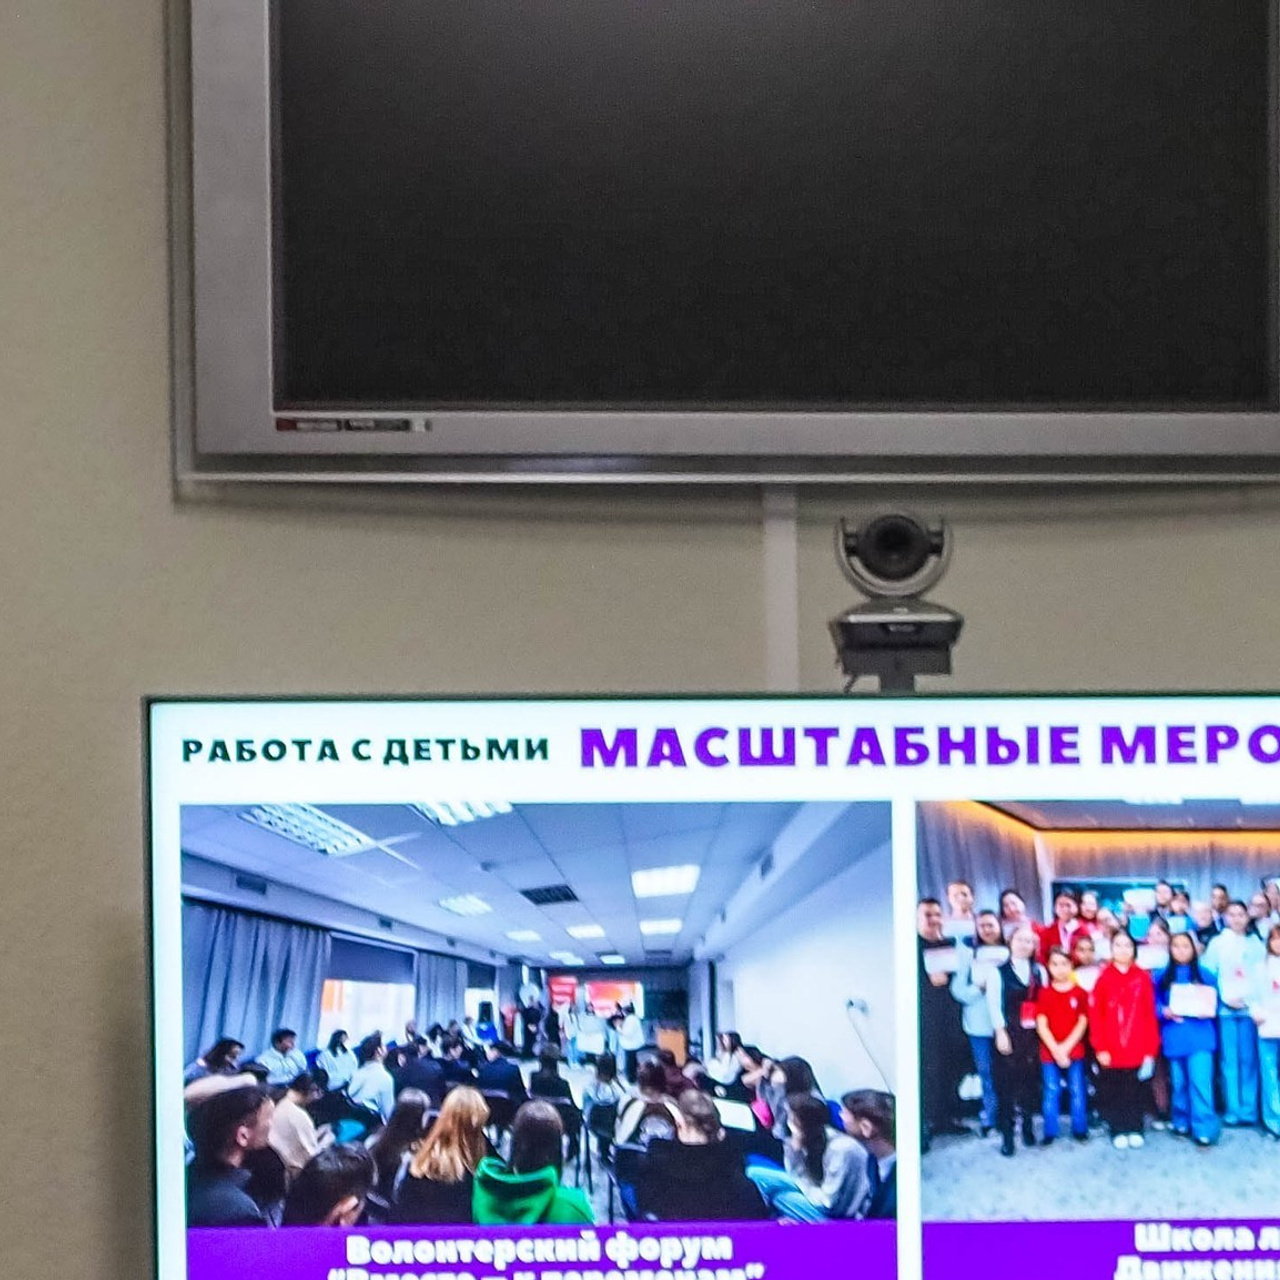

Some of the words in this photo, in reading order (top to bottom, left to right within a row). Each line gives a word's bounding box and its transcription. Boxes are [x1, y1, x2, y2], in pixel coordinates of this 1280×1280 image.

[182, 738, 340, 763] РАБОТА
[351, 738, 372, 762] С
[382, 737, 549, 766] ДЕТЬМИ
[579, 725, 1081, 768] МАСШТАБНЫЕ
[345, 1229, 601, 1271] Волонтерский
[604, 1230, 733, 1269] форум
[1134, 1222, 1255, 1252] Школа
